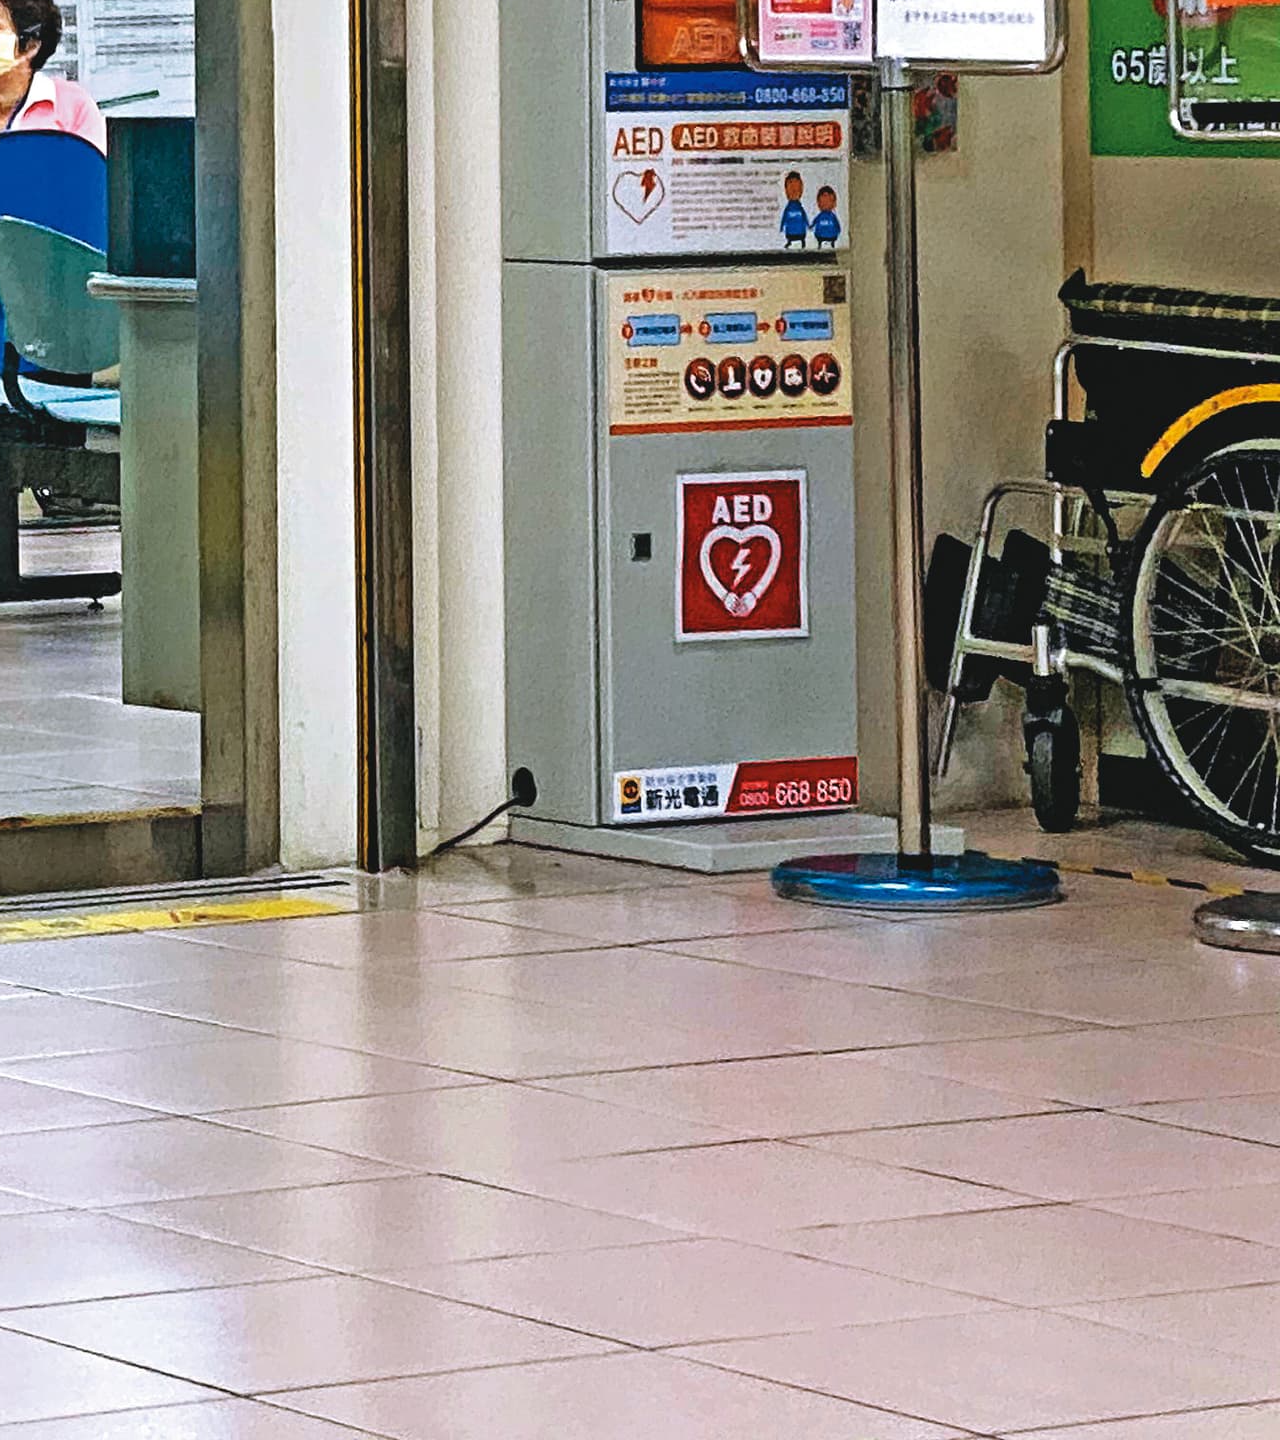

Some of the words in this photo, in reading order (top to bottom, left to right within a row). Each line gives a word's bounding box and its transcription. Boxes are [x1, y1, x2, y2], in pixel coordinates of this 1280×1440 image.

[1112, 45, 1238, 85] 65歲以上
[755, 86, 845, 103] 0800-668-850
[613, 127, 663, 156] AED
[680, 127, 718, 148] AED
[712, 495, 772, 524] AED
[776, 781, 810, 807] 668
[817, 778, 851, 803] 850
